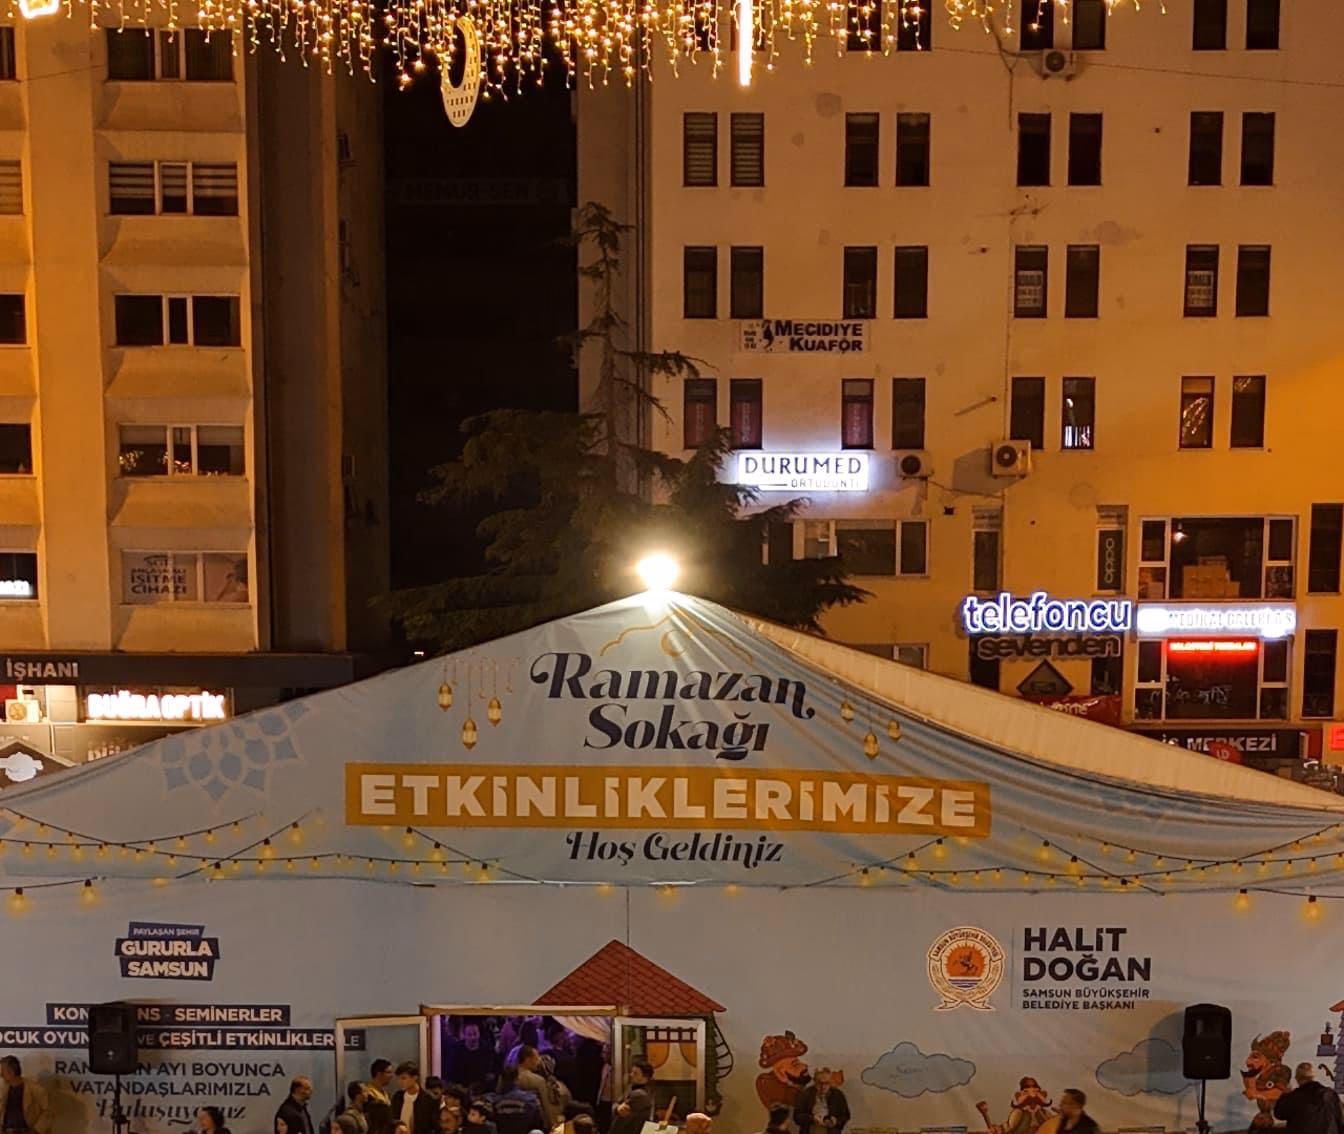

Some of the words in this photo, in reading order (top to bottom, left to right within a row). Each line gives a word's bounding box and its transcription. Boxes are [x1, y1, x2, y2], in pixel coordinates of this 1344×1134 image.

[745, 457, 862, 474] DURUMED
[964, 593, 1132, 632] telefoncu
[6, 657, 79, 680] İŞHANI
[529, 651, 815, 719] Ramazan
[584, 701, 771, 762] Sokağı
[359, 772, 977, 829] ETKİNLİKLERİMİZE
[566, 831, 637, 866] Hoş
[642, 831, 784, 869] Geldiniz
[1024, 926, 1128, 951] HALİT
[121, 940, 213, 957] GURURLA
[127, 961, 208, 977] SAMSUN
[1023, 953, 1151, 981] DOĞAN
[1022, 988, 1072, 998] SAMSUN
[1075, 986, 1150, 1000] BÜYÜKŞEHİR
[174, 1004, 283, 1022] SEMİNERLER
[1022, 999, 1079, 1009] BELEDİYE
[1082, 999, 1135, 1010] BAŞKANI
[159, 1030, 222, 1047] ÇEŞİTLİ
[157, 1063, 187, 1077] AYI
[191, 1063, 286, 1077] BOYUNCA
[70, 1081, 271, 1097] VATANDAŞLARIMIZLA
